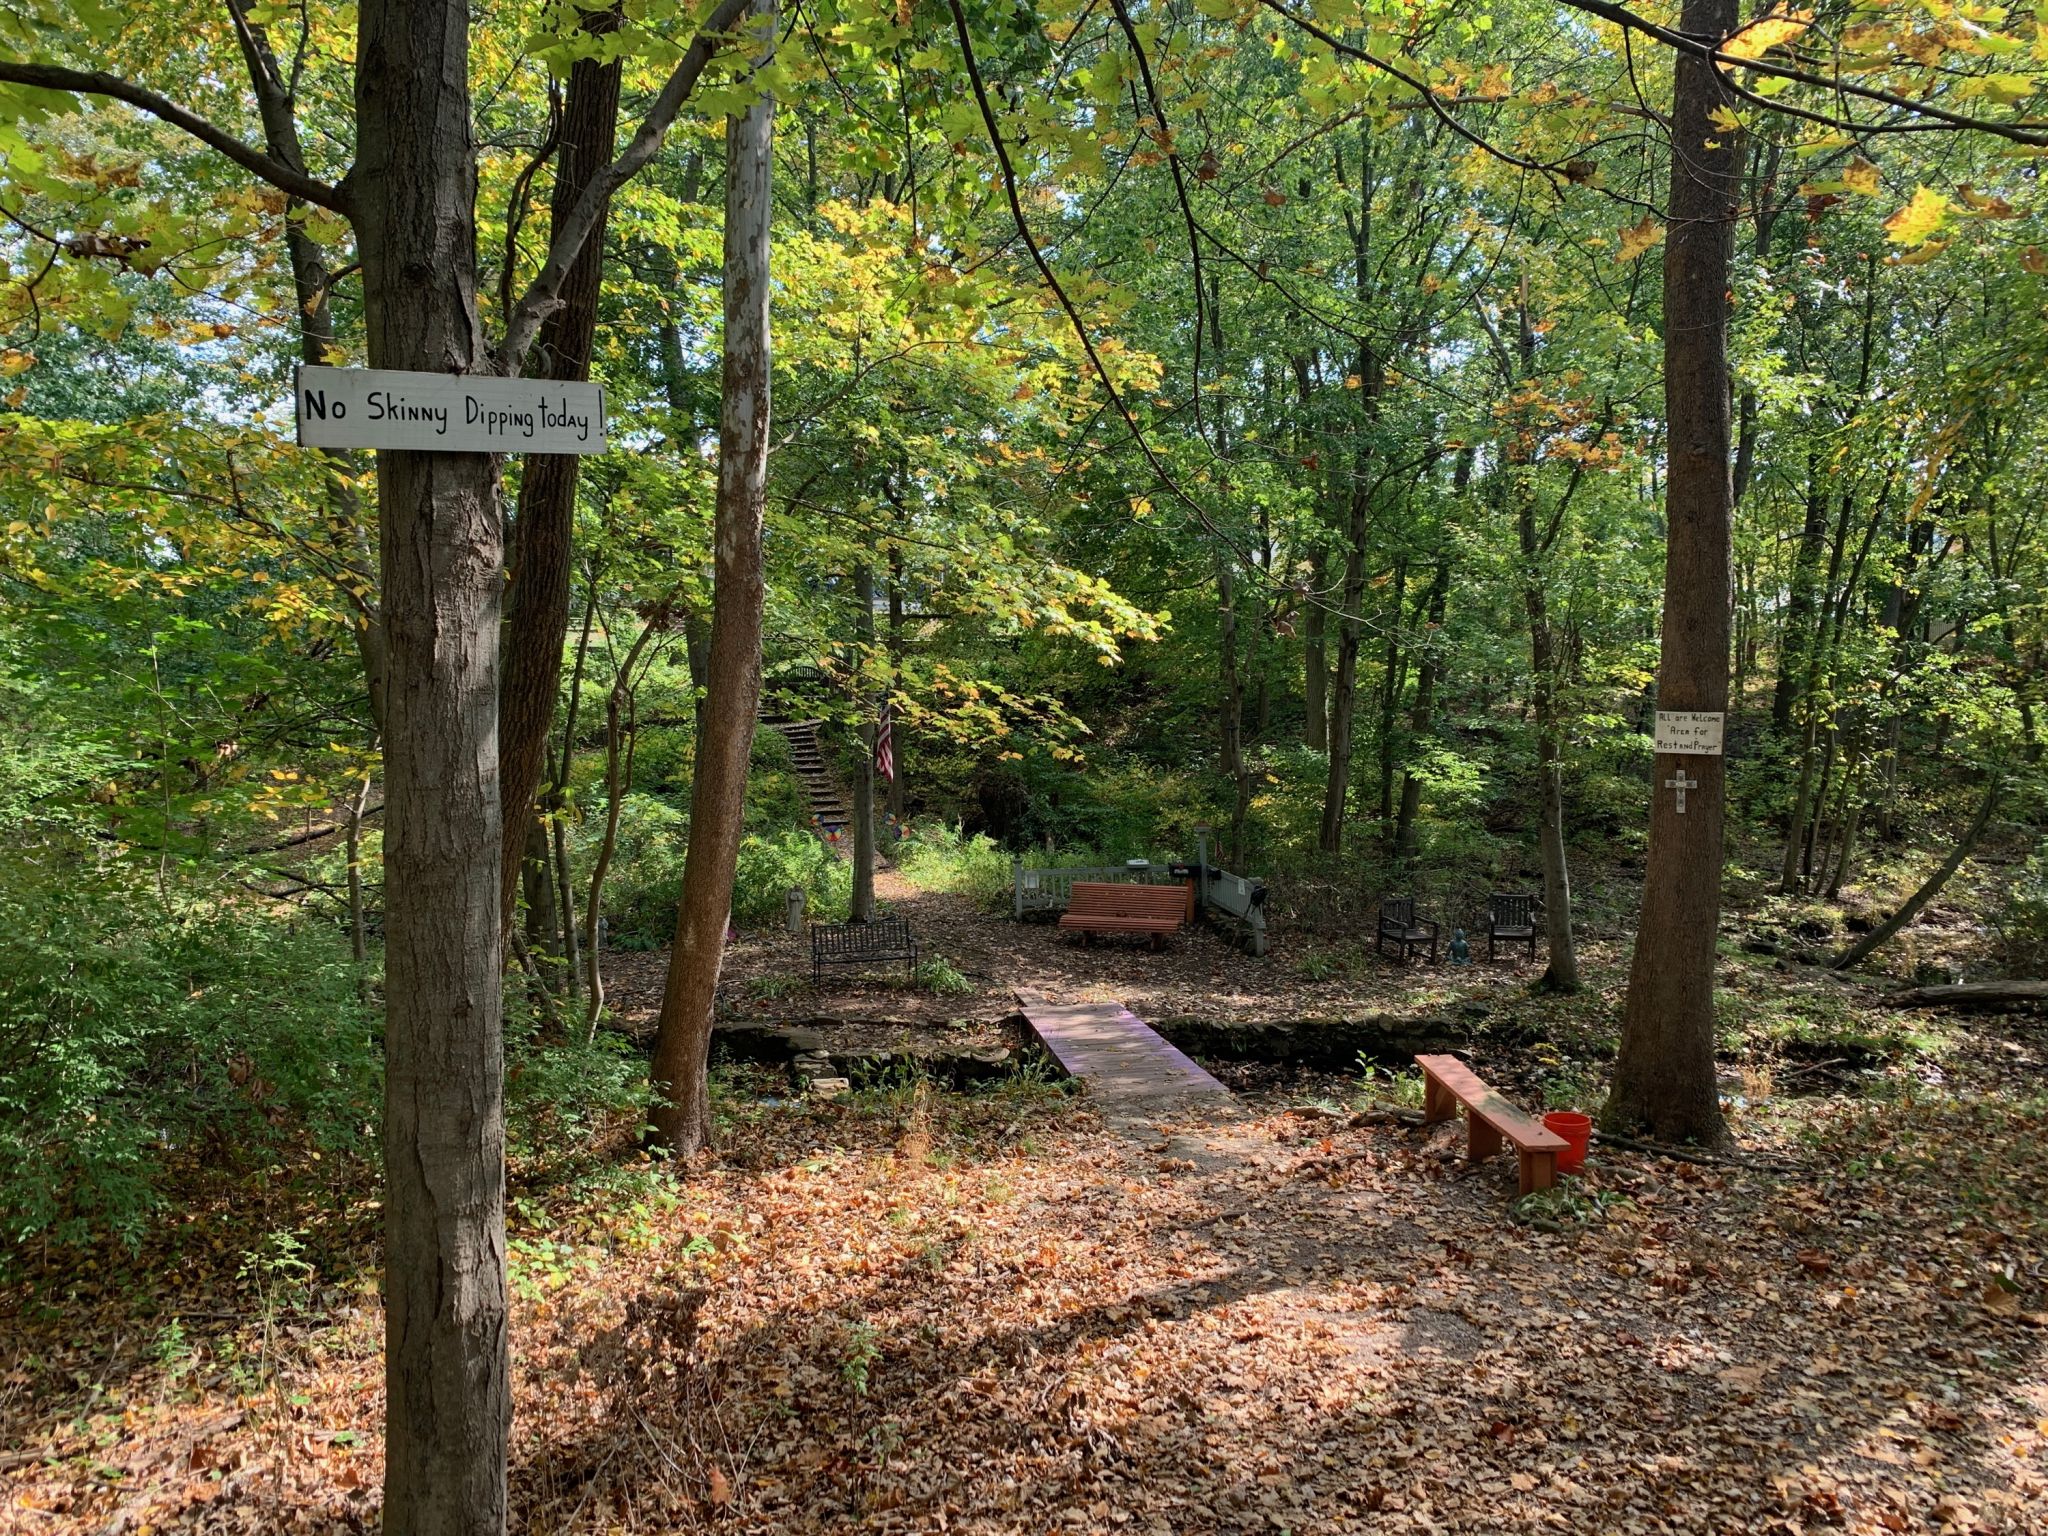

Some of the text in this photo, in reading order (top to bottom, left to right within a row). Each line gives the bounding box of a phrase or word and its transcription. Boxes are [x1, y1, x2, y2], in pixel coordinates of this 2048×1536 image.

[304, 389, 346, 420] No
[367, 391, 447, 435] Skinny
[465, 395, 534, 438] Dipping
[1691, 713, 1720, 722] Welcome
[1670, 726, 1708, 735] Area for
[1657, 740, 1678, 749] Rest
[1693, 741, 1718, 753] Prayer
